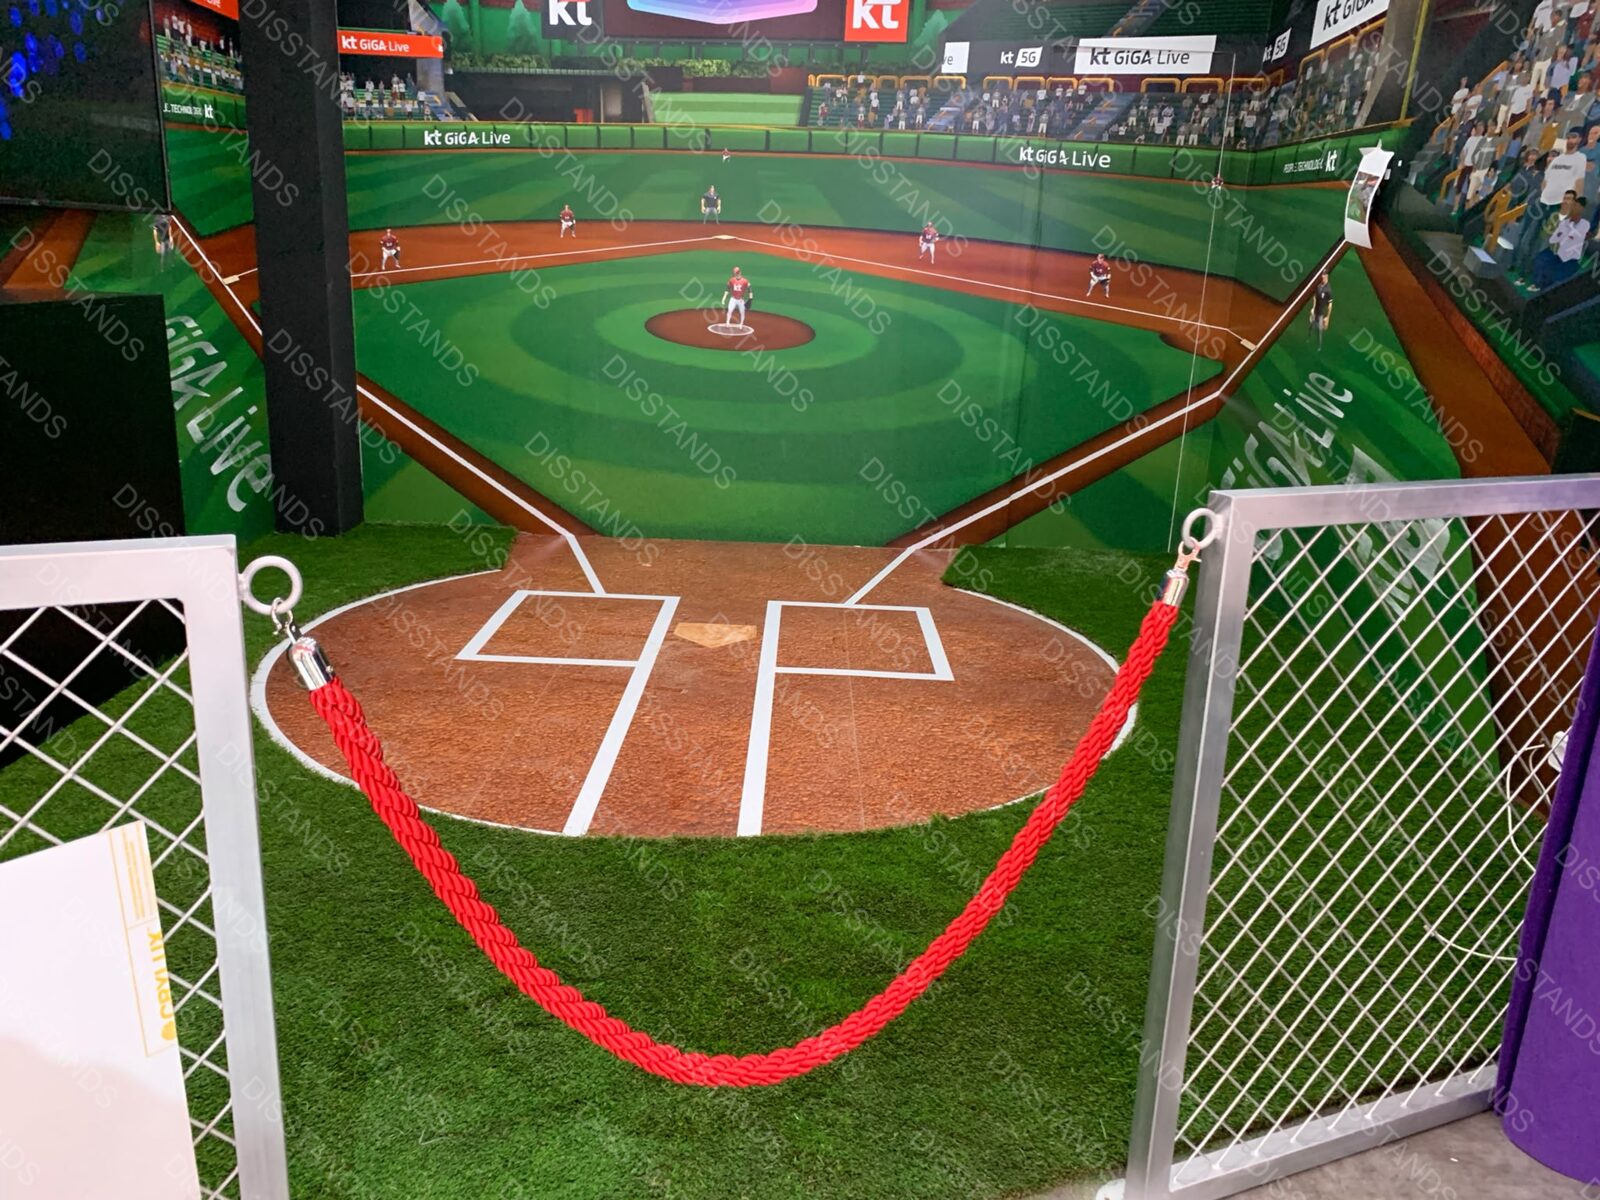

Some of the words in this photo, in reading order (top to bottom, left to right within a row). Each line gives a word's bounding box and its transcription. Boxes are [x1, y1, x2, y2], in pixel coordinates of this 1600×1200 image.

[549, 0, 592, 26] kt
[853, 0, 901, 29] kt
[341, 35, 358, 49] kt
[359, 39, 387, 51] GiGA
[388, 41, 409, 52] Live
[1000, 51, 1015, 64] kt
[1021, 51, 1036, 63] 5G
[1089, 48, 1111, 65] kt
[1114, 50, 1154, 65] GiGA
[1157, 50, 1190, 64] Live
[204, 103, 213, 118] kt
[424, 129, 442, 146] kt
[444, 131, 480, 145] GiGA
[481, 131, 511, 144] Live
[1019, 146, 1034, 162] kt
[1036, 149, 1070, 165] GiGA
[1072, 150, 1111, 168] Live
[1273, 372, 1353, 448] Live
[186, 386, 274, 512] Live
